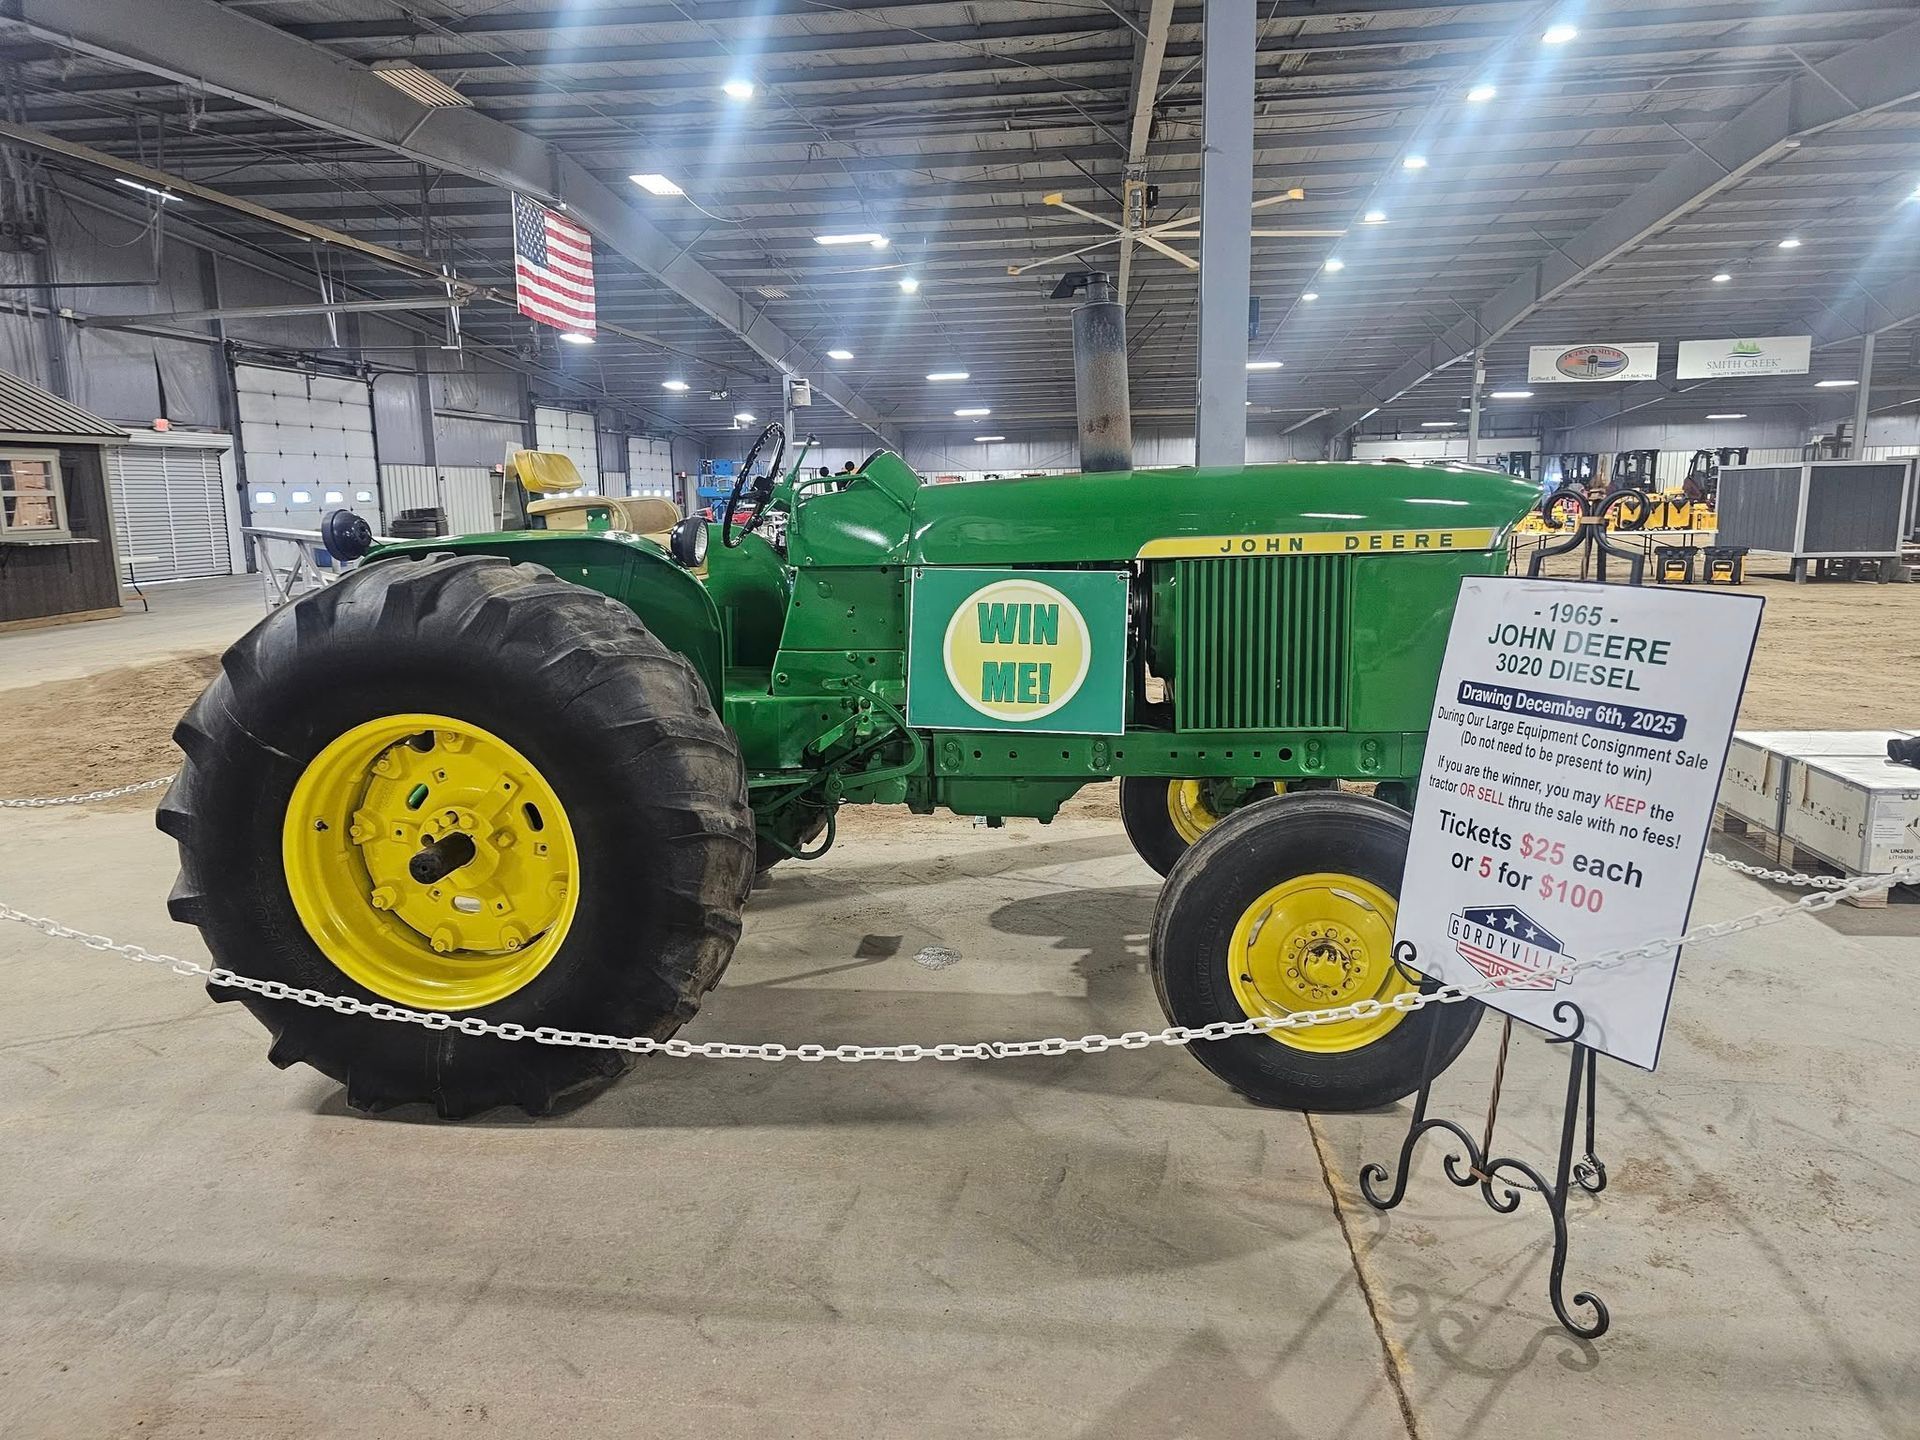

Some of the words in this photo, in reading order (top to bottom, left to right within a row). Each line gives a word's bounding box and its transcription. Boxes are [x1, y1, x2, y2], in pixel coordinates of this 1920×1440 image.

[1707, 360, 1740, 369] SMITH
[1744, 359, 1779, 368] CREEK
[1220, 538, 1303, 553] JOHN
[1345, 534, 1454, 550] DEERE
[977, 602, 1060, 646] WIN
[1550, 603, 1603, 626] 1965
[1488, 624, 1556, 651] JOHN
[1563, 631, 1671, 665] DEERE
[981, 661, 1052, 705] ME!
[1496, 653, 1542, 676] 3020
[1549, 660, 1640, 691] DIESEL
[1463, 684, 1512, 710] Drawing
[1516, 693, 1592, 719] December
[1596, 706, 1625, 728] 6th,
[1631, 712, 1676, 734] 2025
[1438, 706, 1465, 726] During
[1467, 712, 1484, 727] Our
[1486, 715, 1514, 735] Large
[1516, 721, 1578, 746] Equipment
[1582, 733, 1672, 763] Consignment
[1675, 750, 1708, 770] Sale
[1461, 730, 1477, 747] (Do
[1478, 737, 1495, 750] not
[1497, 741, 1523, 756] need
[1525, 744, 1536, 758] to
[1538, 746, 1553, 762] be
[1555, 754, 1603, 772] present
[1606, 760, 1619, 775] to
[1624, 765, 1652, 786] win)
[1429, 774, 1458, 793] tractor
[1460, 782, 1475, 798] OR
[1477, 787, 1504, 806] SELL
[1508, 795, 1531, 813] thru
[1535, 802, 1554, 818] the
[1556, 810, 1583, 825] sale
[1588, 816, 1615, 834] with
[1619, 825, 1638, 839] no
[1642, 827, 1681, 849] fees!
[1438, 755, 1445, 768] If
[1444, 760, 1462, 773] you
[1464, 765, 1480, 777] are
[1482, 766, 1499, 782] the
[1502, 772, 1542, 795] winner,
[1545, 784, 1570, 798] you
[1572, 790, 1601, 808] may
[1604, 793, 1646, 814] KEEP
[1650, 804, 1674, 822] the
[1440, 809, 1512, 850] Tickets
[1520, 833, 1565, 865] $25
[1573, 854, 1642, 888] each
[1452, 852, 1474, 872] or
[1479, 856, 1492, 878] 5
[1498, 862, 1533, 891] for
[1539, 874, 1603, 912] $100
